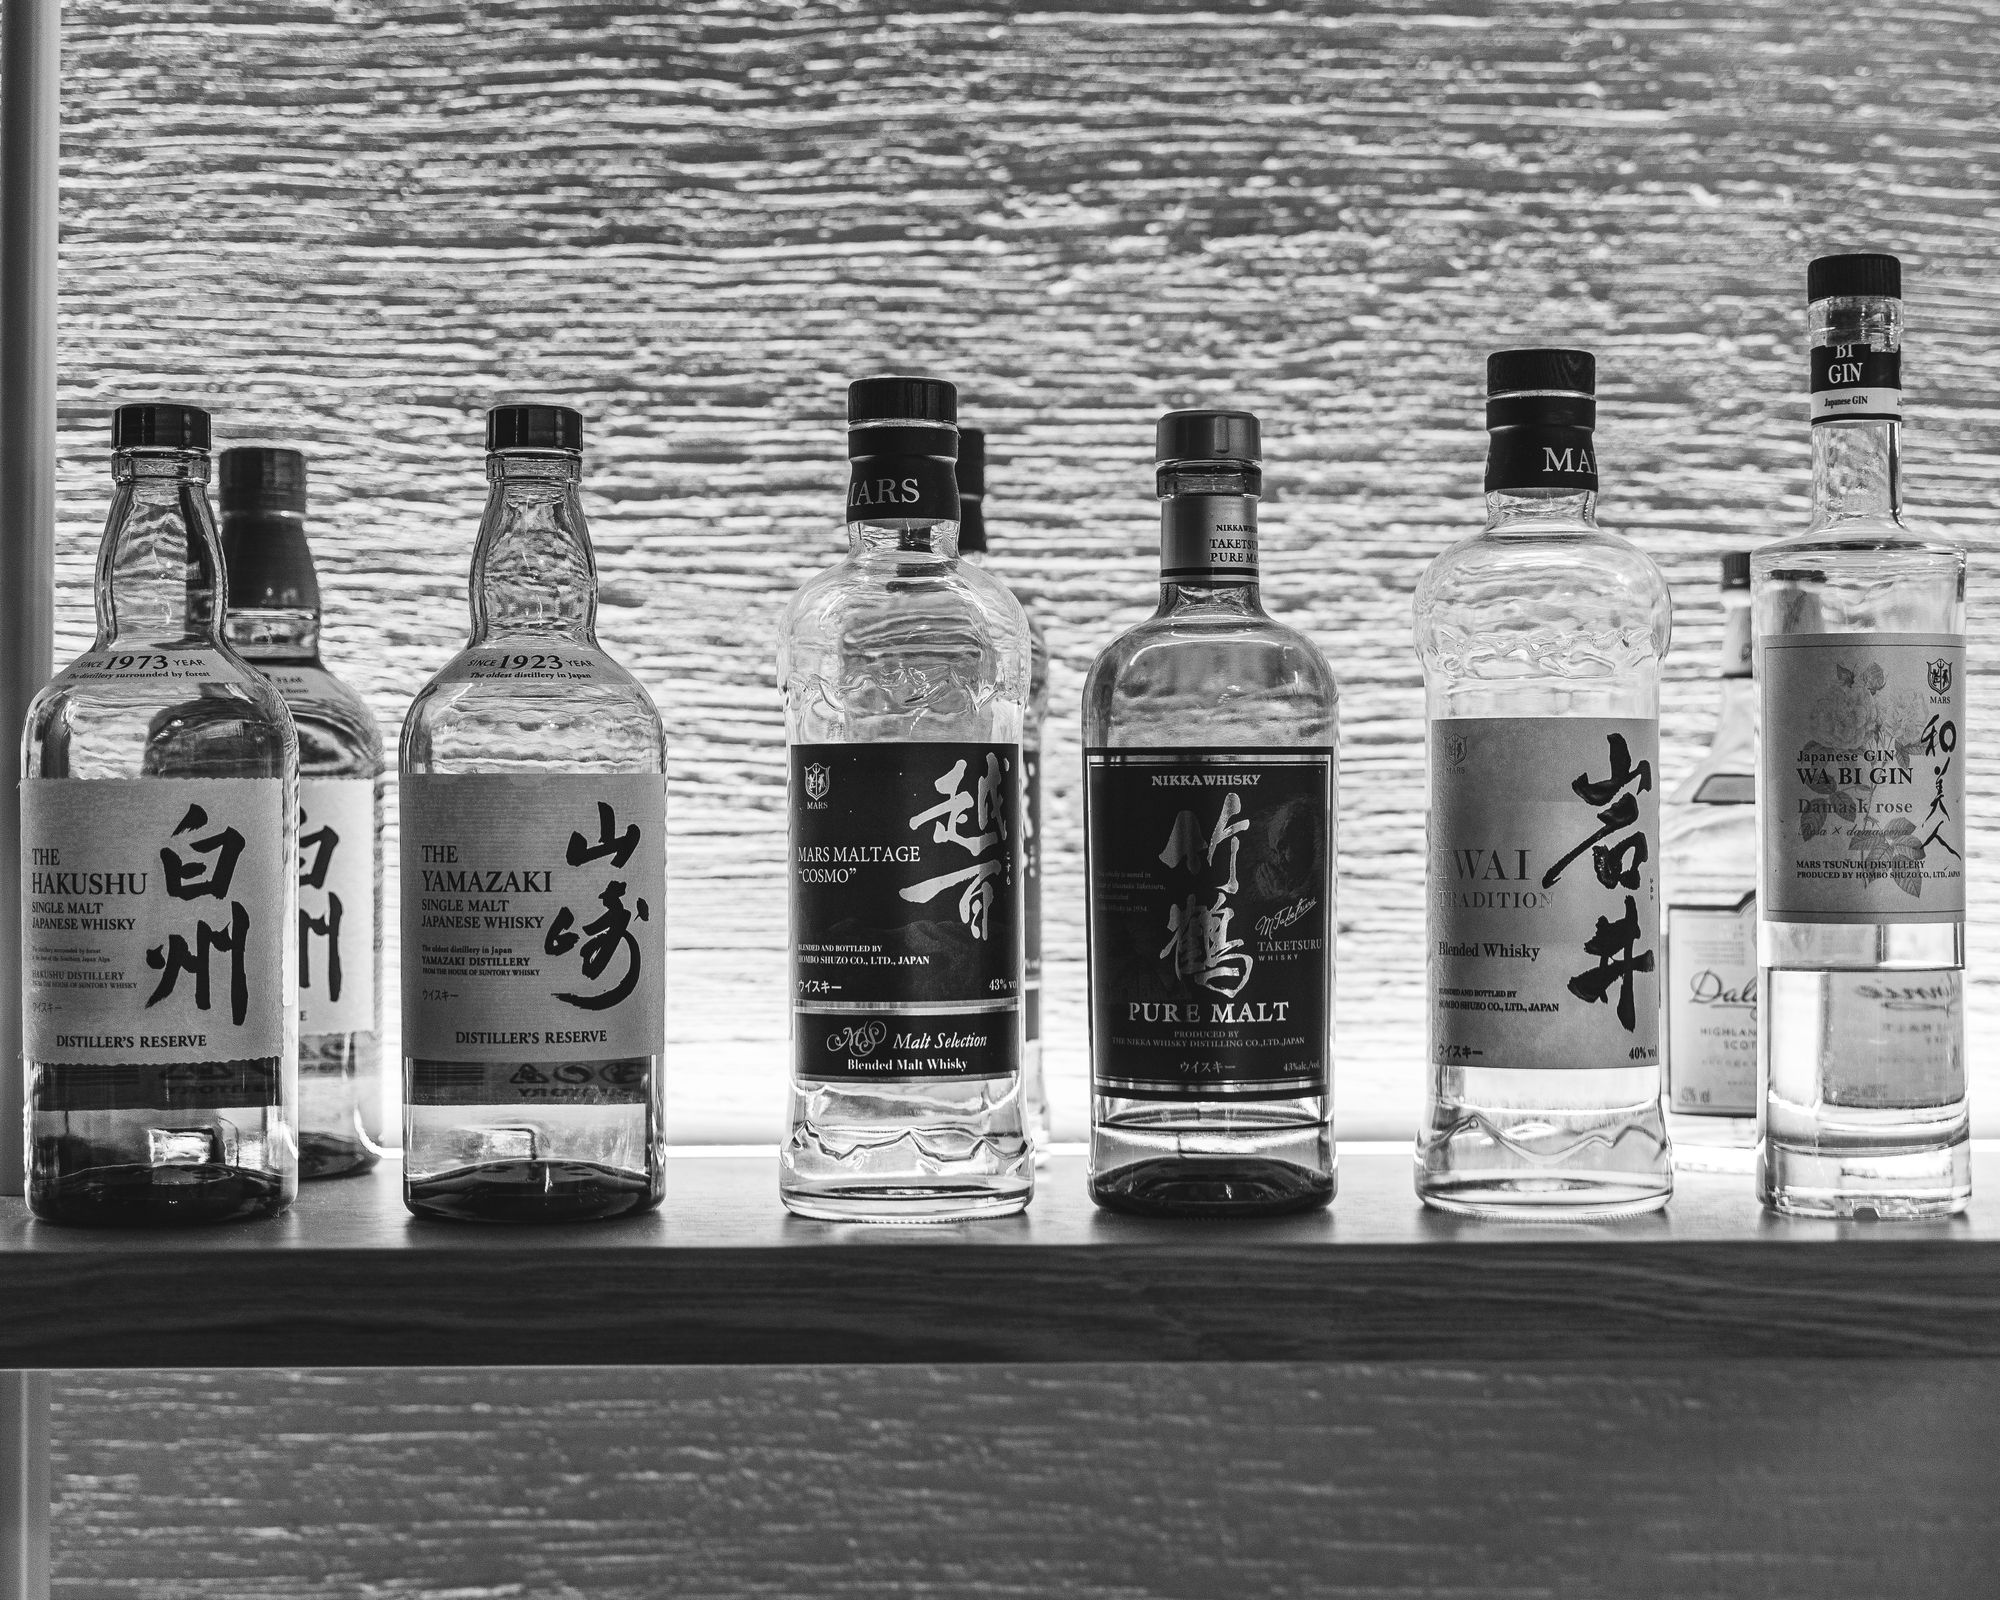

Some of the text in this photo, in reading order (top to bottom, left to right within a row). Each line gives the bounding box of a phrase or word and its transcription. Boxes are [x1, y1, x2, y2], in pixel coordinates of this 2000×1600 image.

[1828, 362, 1863, 384] GIN
[1824, 395, 1868, 409] Japanese GIN
[1209, 538, 1258, 550] TAKETSU
[1210, 552, 1243, 562] PURE
[104, 655, 168, 670] 1973
[172, 659, 206, 667] YEAR
[467, 654, 595, 670] SINCE 1923 YEAR
[79, 672, 113, 680] distillery
[171, 671, 182, 679] by
[514, 672, 554, 680] distillery
[1929, 696, 1951, 704] MARS
[1797, 749, 1895, 765] Japanese GIN
[1796, 767, 1914, 785] WA BI GIN
[1920, 713, 1962, 861] 和美人
[807, 801, 829, 810] MARS
[1798, 798, 1913, 814] Damask rose
[31, 848, 60, 866] THE
[421, 845, 459, 863] THE
[798, 845, 920, 862] MARS MALTAGE
[1796, 860, 1925, 869] MARS TSUNUKI DISTILLERY
[422, 870, 552, 893] YAMAZAKI
[1796, 871, 1840, 879] PRODUCED
[1842, 871, 1854, 879] BY
[1856, 871, 1887, 879] HOMBO
[1889, 871, 1917, 879] SHUZO
[32, 872, 148, 895] HAKUSHU
[1541, 733, 1655, 1032] 岩井
[422, 898, 509, 912] SINGLE MALT
[544, 801, 649, 1011] 山崎
[1439, 890, 1554, 909] TRADITION
[31, 901, 104, 915] SINGLE MALT
[145, 803, 250, 1026] 白州
[32, 917, 136, 931] JAPANESE WHISKY
[421, 915, 544, 929] JAPANESE WHISKY
[422, 944, 512, 955] The oldest distillery in Japan
[820, 944, 835, 952] AND
[872, 944, 883, 952] BY
[1257, 939, 1322, 952] TAKETSURU
[1438, 941, 1541, 961] Blended Whisky
[422, 955, 530, 967] YAMAZAKI DISTILLERY
[820, 955, 848, 965] SHUZO
[850, 956, 869, 966] CO.,
[870, 956, 896, 966] LTD.,
[898, 955, 930, 965] JAPAN
[1258, 953, 1299, 961] WHISKY
[67, 971, 125, 980] DISTILLERY
[422, 967, 436, 975] FROM
[448, 968, 468, 976] HOUSE
[798, 979, 842, 994] ウイスキー
[989, 979, 1007, 991] 43%
[422, 989, 459, 1001] ウイスキー
[1460, 988, 1473, 997] AND
[1474, 989, 1506, 998] BOTTLED
[1507, 990, 1517, 998] BY
[1128, 1001, 1289, 1023] PURE MALT
[1460, 1001, 1486, 1011] SHUZO
[1487, 1002, 1504, 1012] CO.,
[1504, 1002, 1527, 1012] LTD.,
[1528, 1003, 1559, 1012] JAPAN
[140, 1034, 207, 1048] RESERVE
[545, 1030, 607, 1044] RESERVE
[893, 1032, 931, 1049] Malt
[934, 1032, 988, 1049] Selection
[1174, 1030, 1239, 1038] PRODUCED BY
[1112, 1036, 1125, 1045] THE
[1125, 1037, 1151, 1047] NIKKA
[1153, 1038, 1187, 1047] WHISKY
[1190, 1039, 1243, 1048] DISTILLING
[1438, 1043, 1483, 1059] ウイスキー
[1628, 1046, 1647, 1060] 40%
[848, 1058, 968, 1072] Blended Malt Whisky
[1180, 1060, 1236, 1074] ウイスキー
